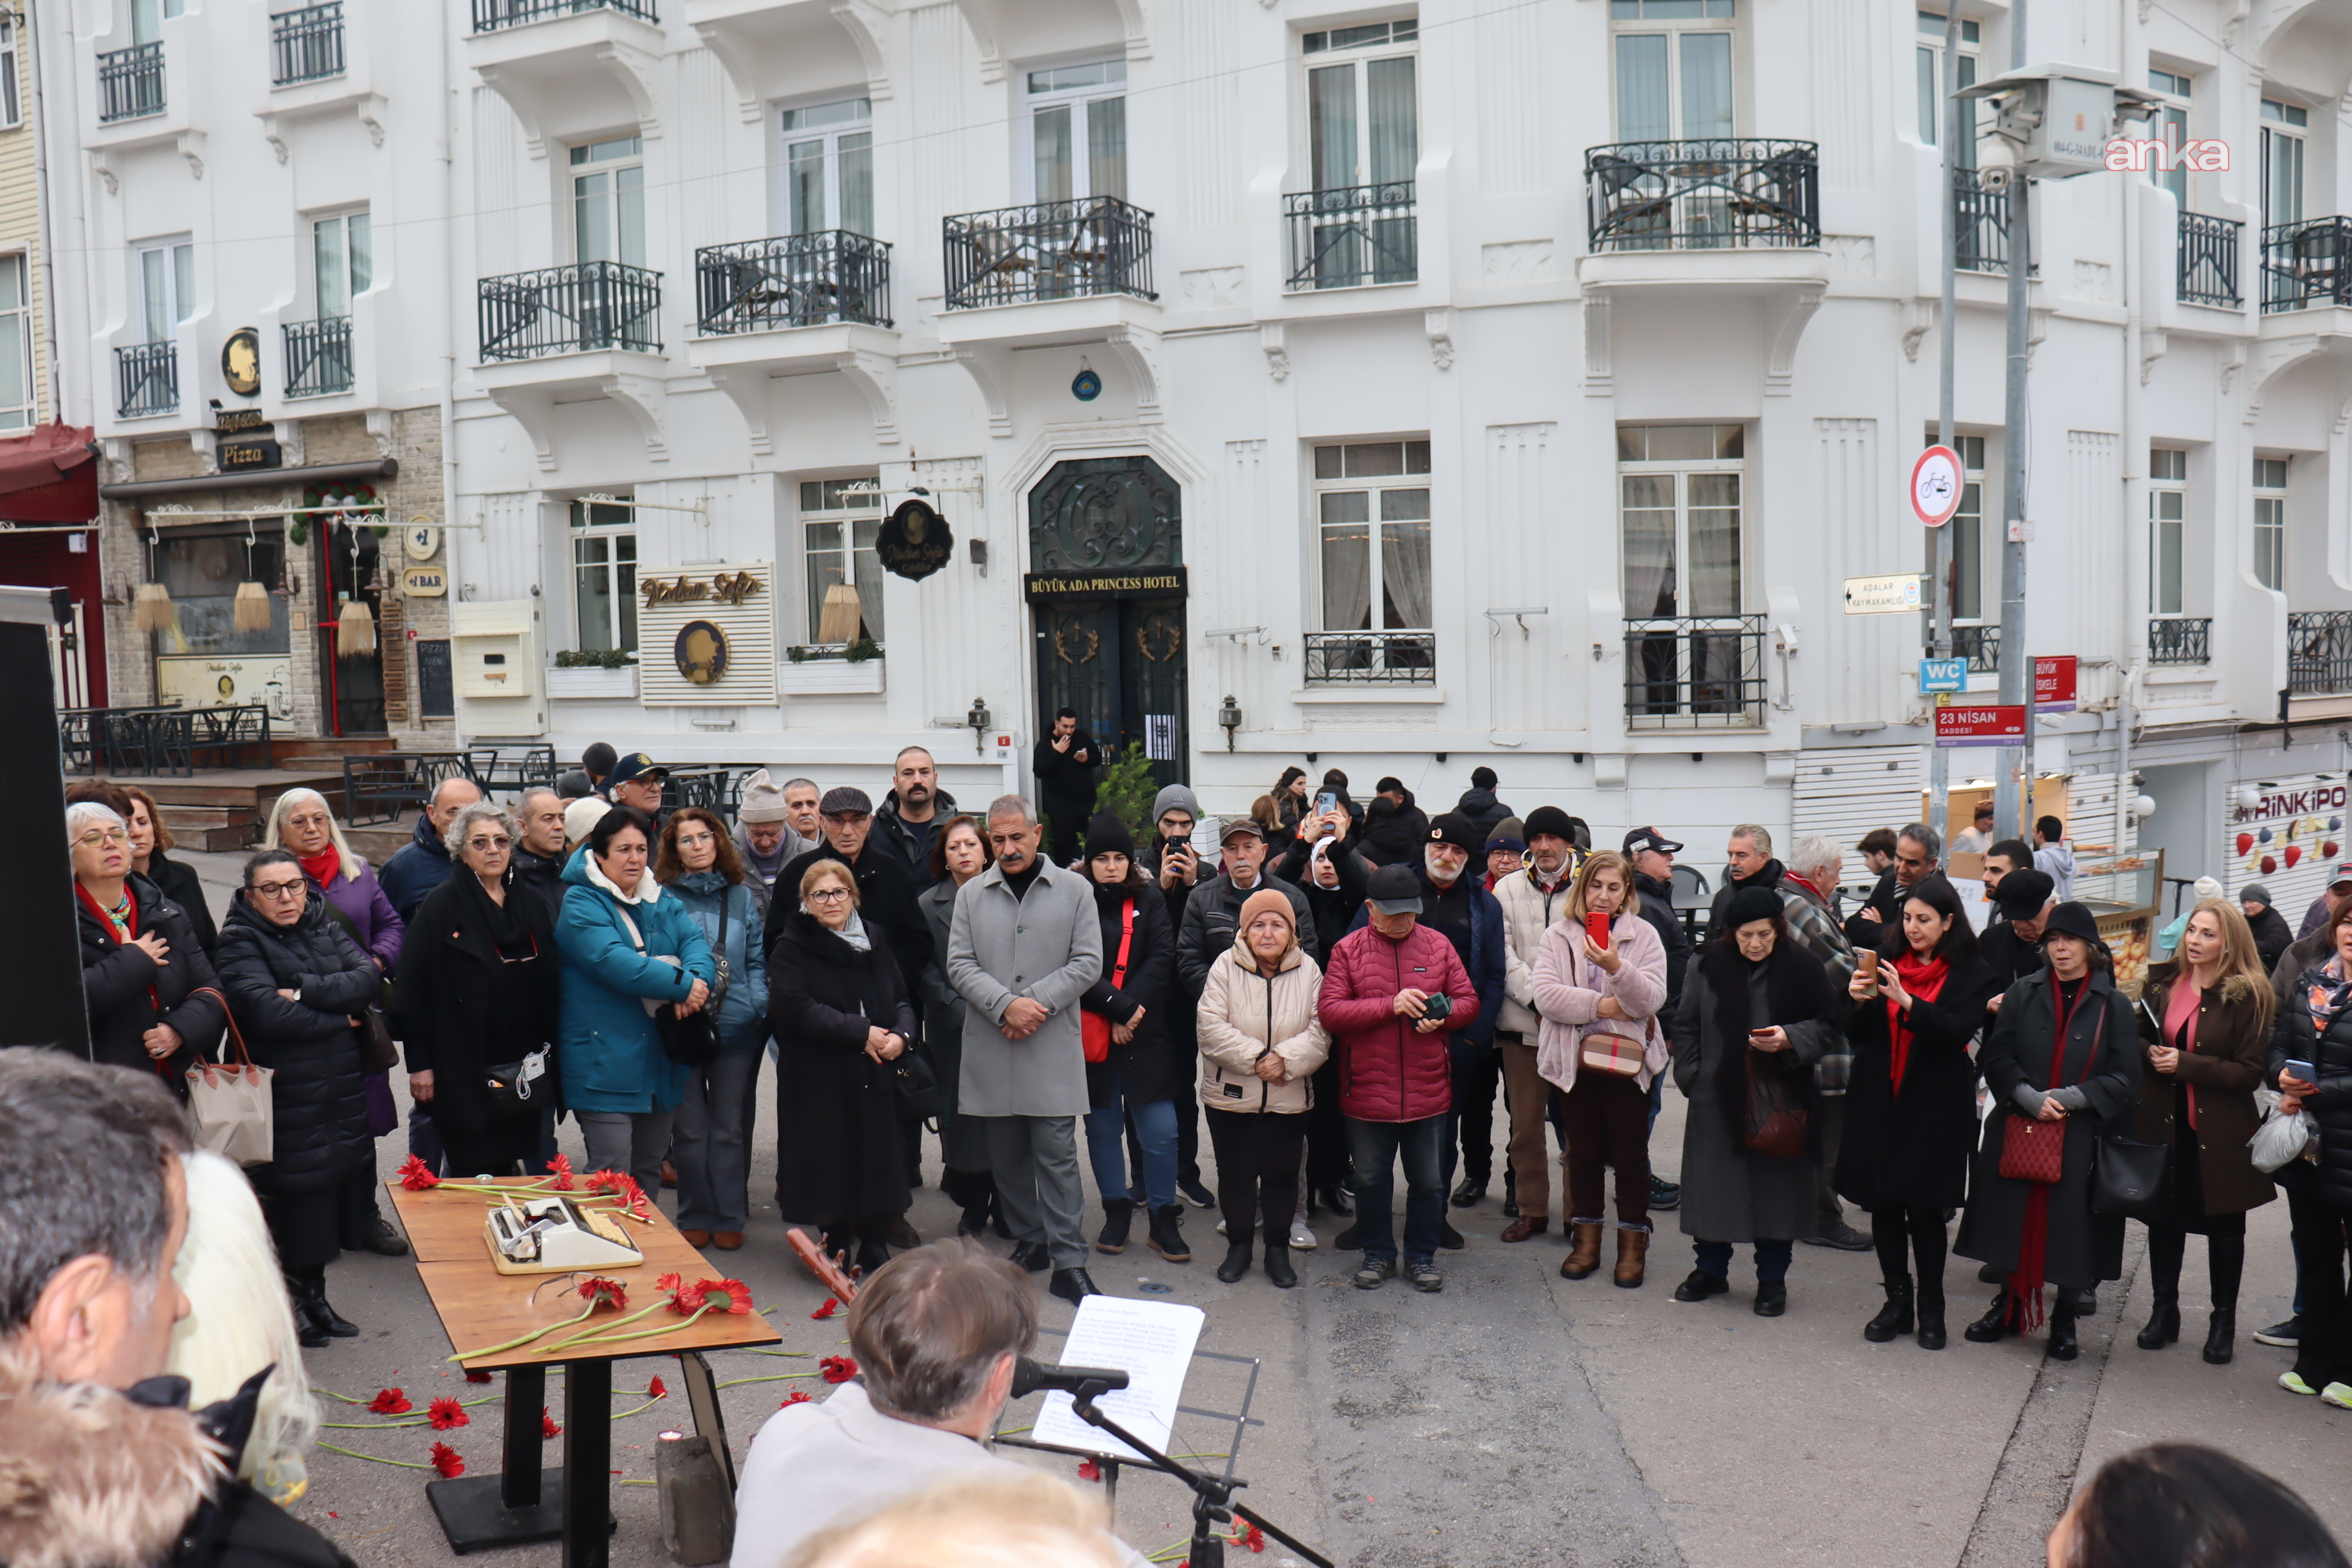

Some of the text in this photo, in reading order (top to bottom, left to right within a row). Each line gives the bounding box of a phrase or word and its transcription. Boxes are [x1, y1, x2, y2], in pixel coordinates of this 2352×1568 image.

[224, 445, 263, 465] Pizza
[420, 576, 441, 587] BAR
[1031, 576, 1180, 593] BÜYÜK ADA PRINCESS HOTEL
[1863, 583, 1893, 592] ADALAR
[1853, 596, 1905, 607] KAYMAKAMLIĞI
[1926, 664, 1960, 679] WC
[2036, 661, 2057, 675] BÜYÜK
[2036, 678, 2057, 691] İSKELE
[1940, 710, 1997, 724] 23 NİSAN
